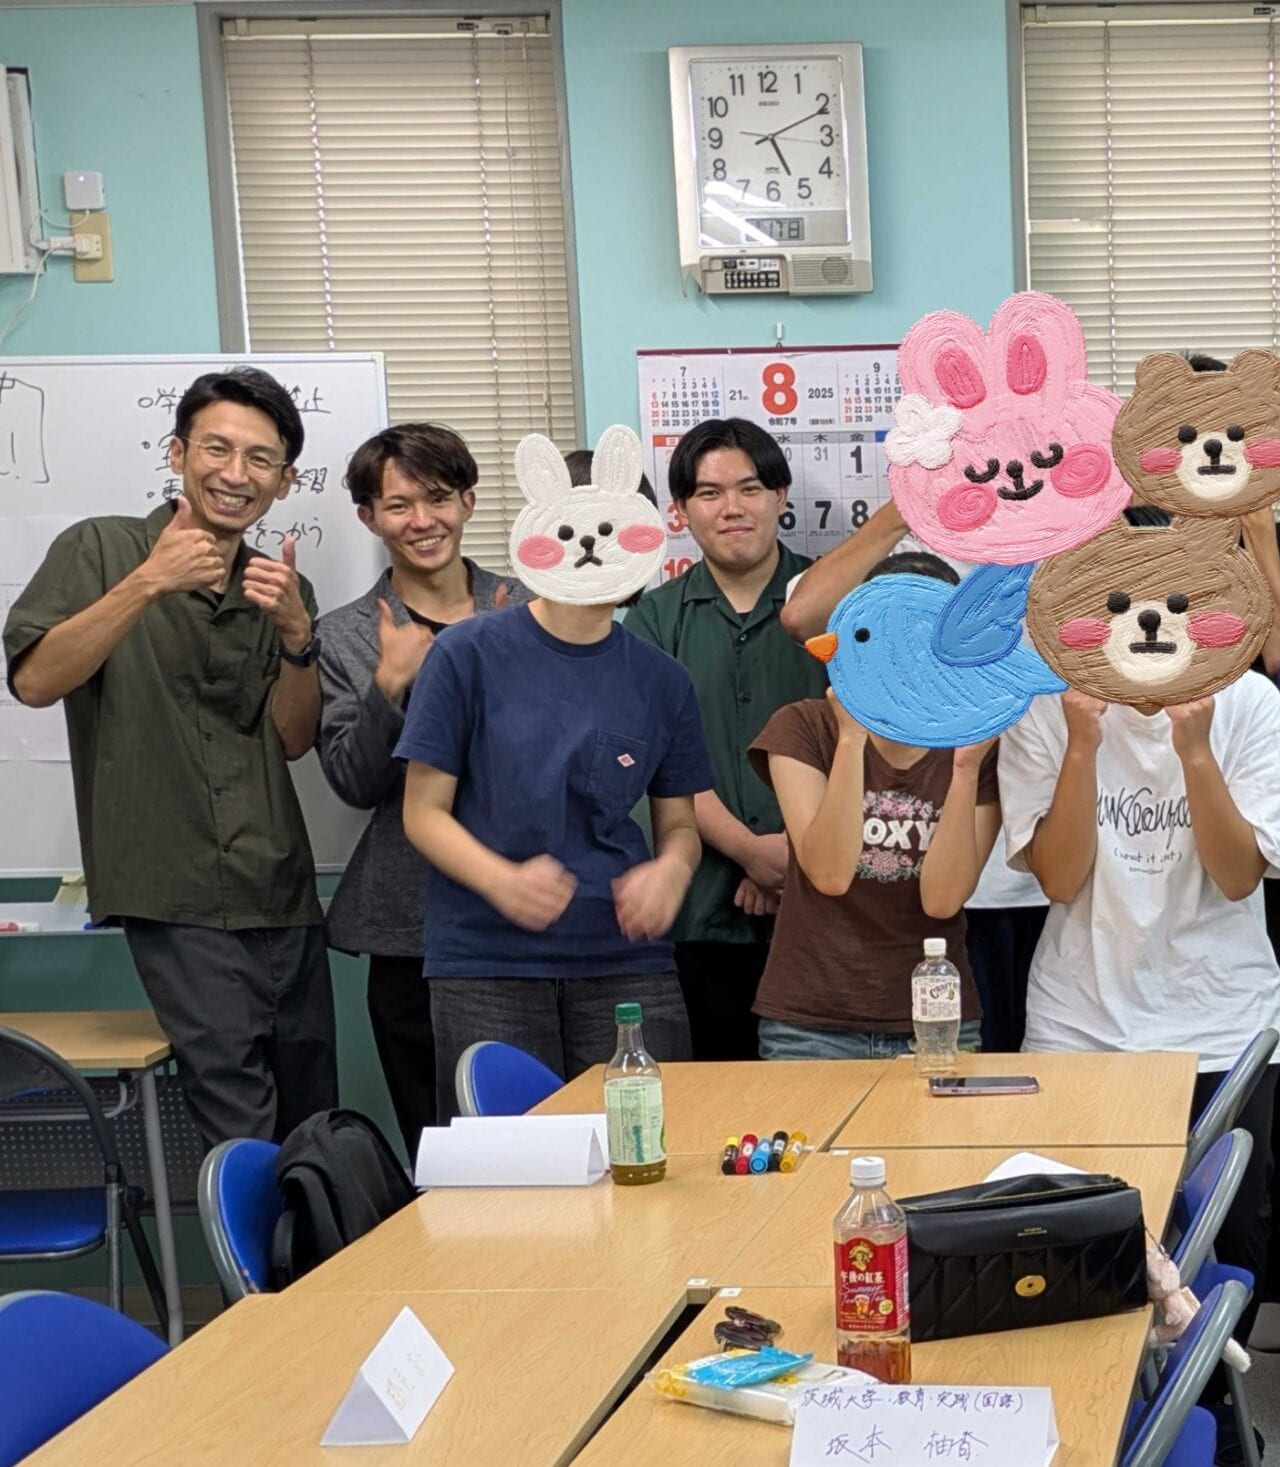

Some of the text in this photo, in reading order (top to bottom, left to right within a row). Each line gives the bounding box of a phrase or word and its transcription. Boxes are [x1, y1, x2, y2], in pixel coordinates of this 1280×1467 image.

[729, 73, 745, 96] 11
[757, 71, 778, 93] 12
[794, 73, 801, 94] 1
[707, 96, 728, 119] 10
[815, 93, 830, 115] 2
[708, 127, 723, 150] 9
[819, 125, 834, 147] 3
[713, 158, 727, 181] 8
[818, 156, 833, 179] 4
[736, 179, 751, 200] 7
[766, 181, 781, 202] 6
[797, 177, 812, 199] 5
[680, 366, 687, 377] 7
[873, 362, 881, 373] 9
[652, 392, 657, 400] 6
[762, 363, 798, 415] 8
[808, 387, 834, 399] 2025
[845, 415, 852, 423] 28
[885, 405, 893, 413] 25
[652, 419, 659, 427] 27
[662, 419, 670, 427] 28
[777, 434, 790, 443] 水
[813, 434, 828, 443] 木
[850, 433, 864, 442] 金
[814, 447, 828, 461] 31
[850, 445, 862, 474] 1
[667, 500, 869, 533] 3 6 7 8
[863, 817, 939, 851] OXY
[840, 1271, 885, 1284] 午後の紅茶
[825, 1425, 893, 1464] 坂本
